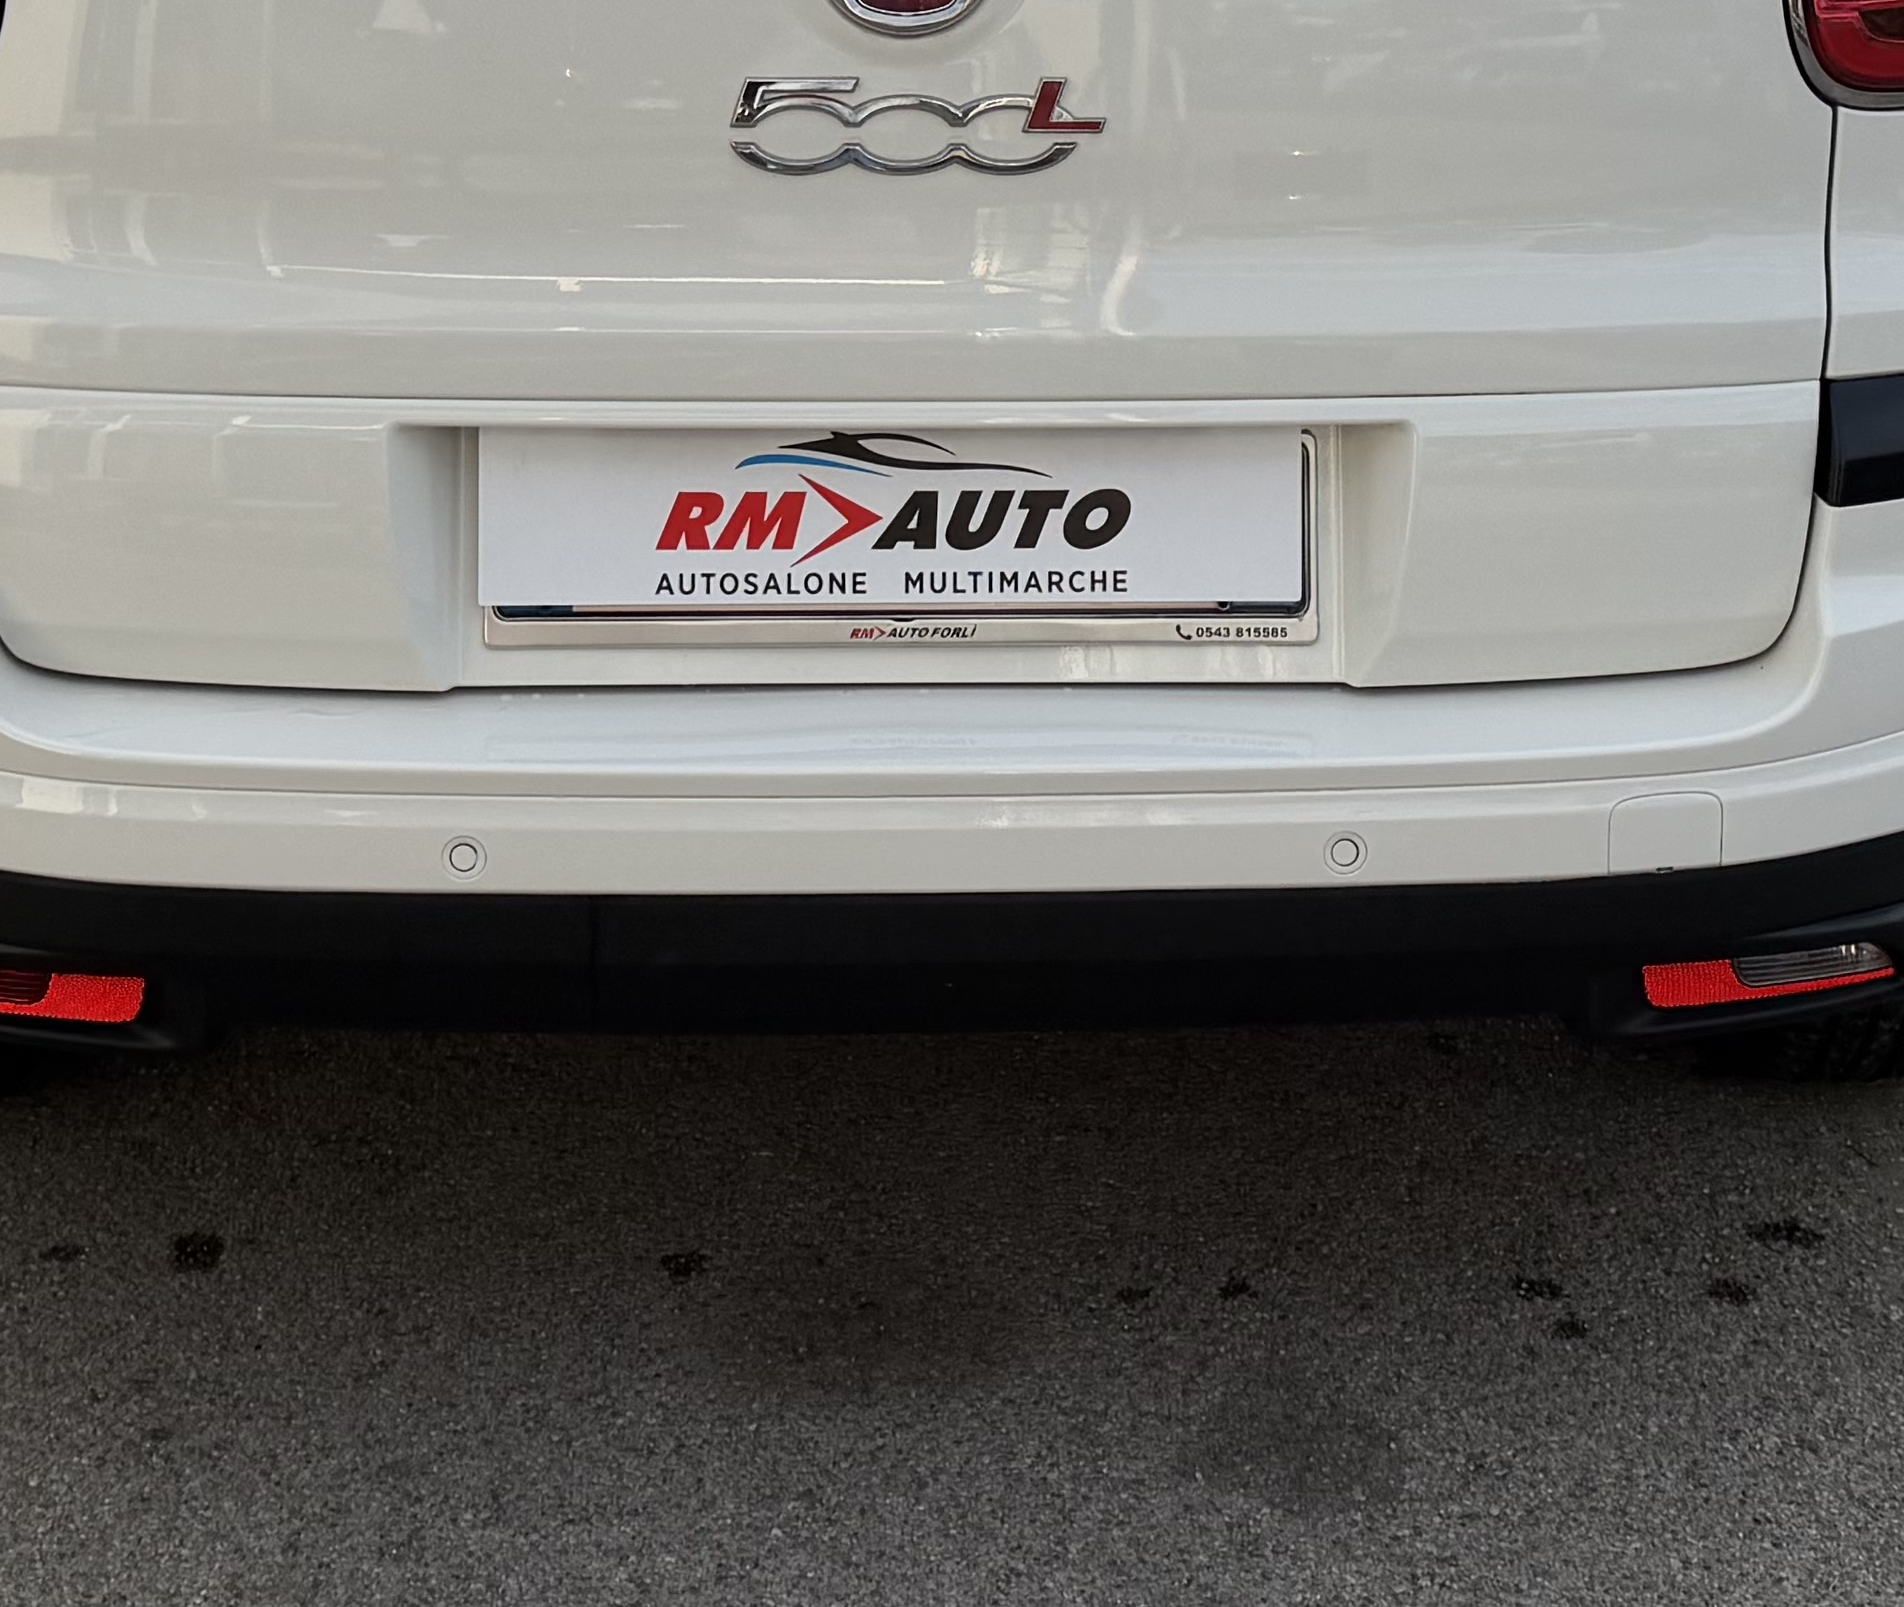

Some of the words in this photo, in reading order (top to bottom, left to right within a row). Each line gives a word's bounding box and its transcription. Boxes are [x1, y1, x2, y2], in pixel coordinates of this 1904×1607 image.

[730, 76, 1107, 176] 500L
[655, 491, 808, 550] RM
[871, 488, 1132, 551] AUTO
[655, 572, 868, 595] AUTOSALONE
[904, 570, 1128, 594] MULTIMARCHE
[850, 628, 875, 639] RM
[1196, 627, 1231, 638] 0543
